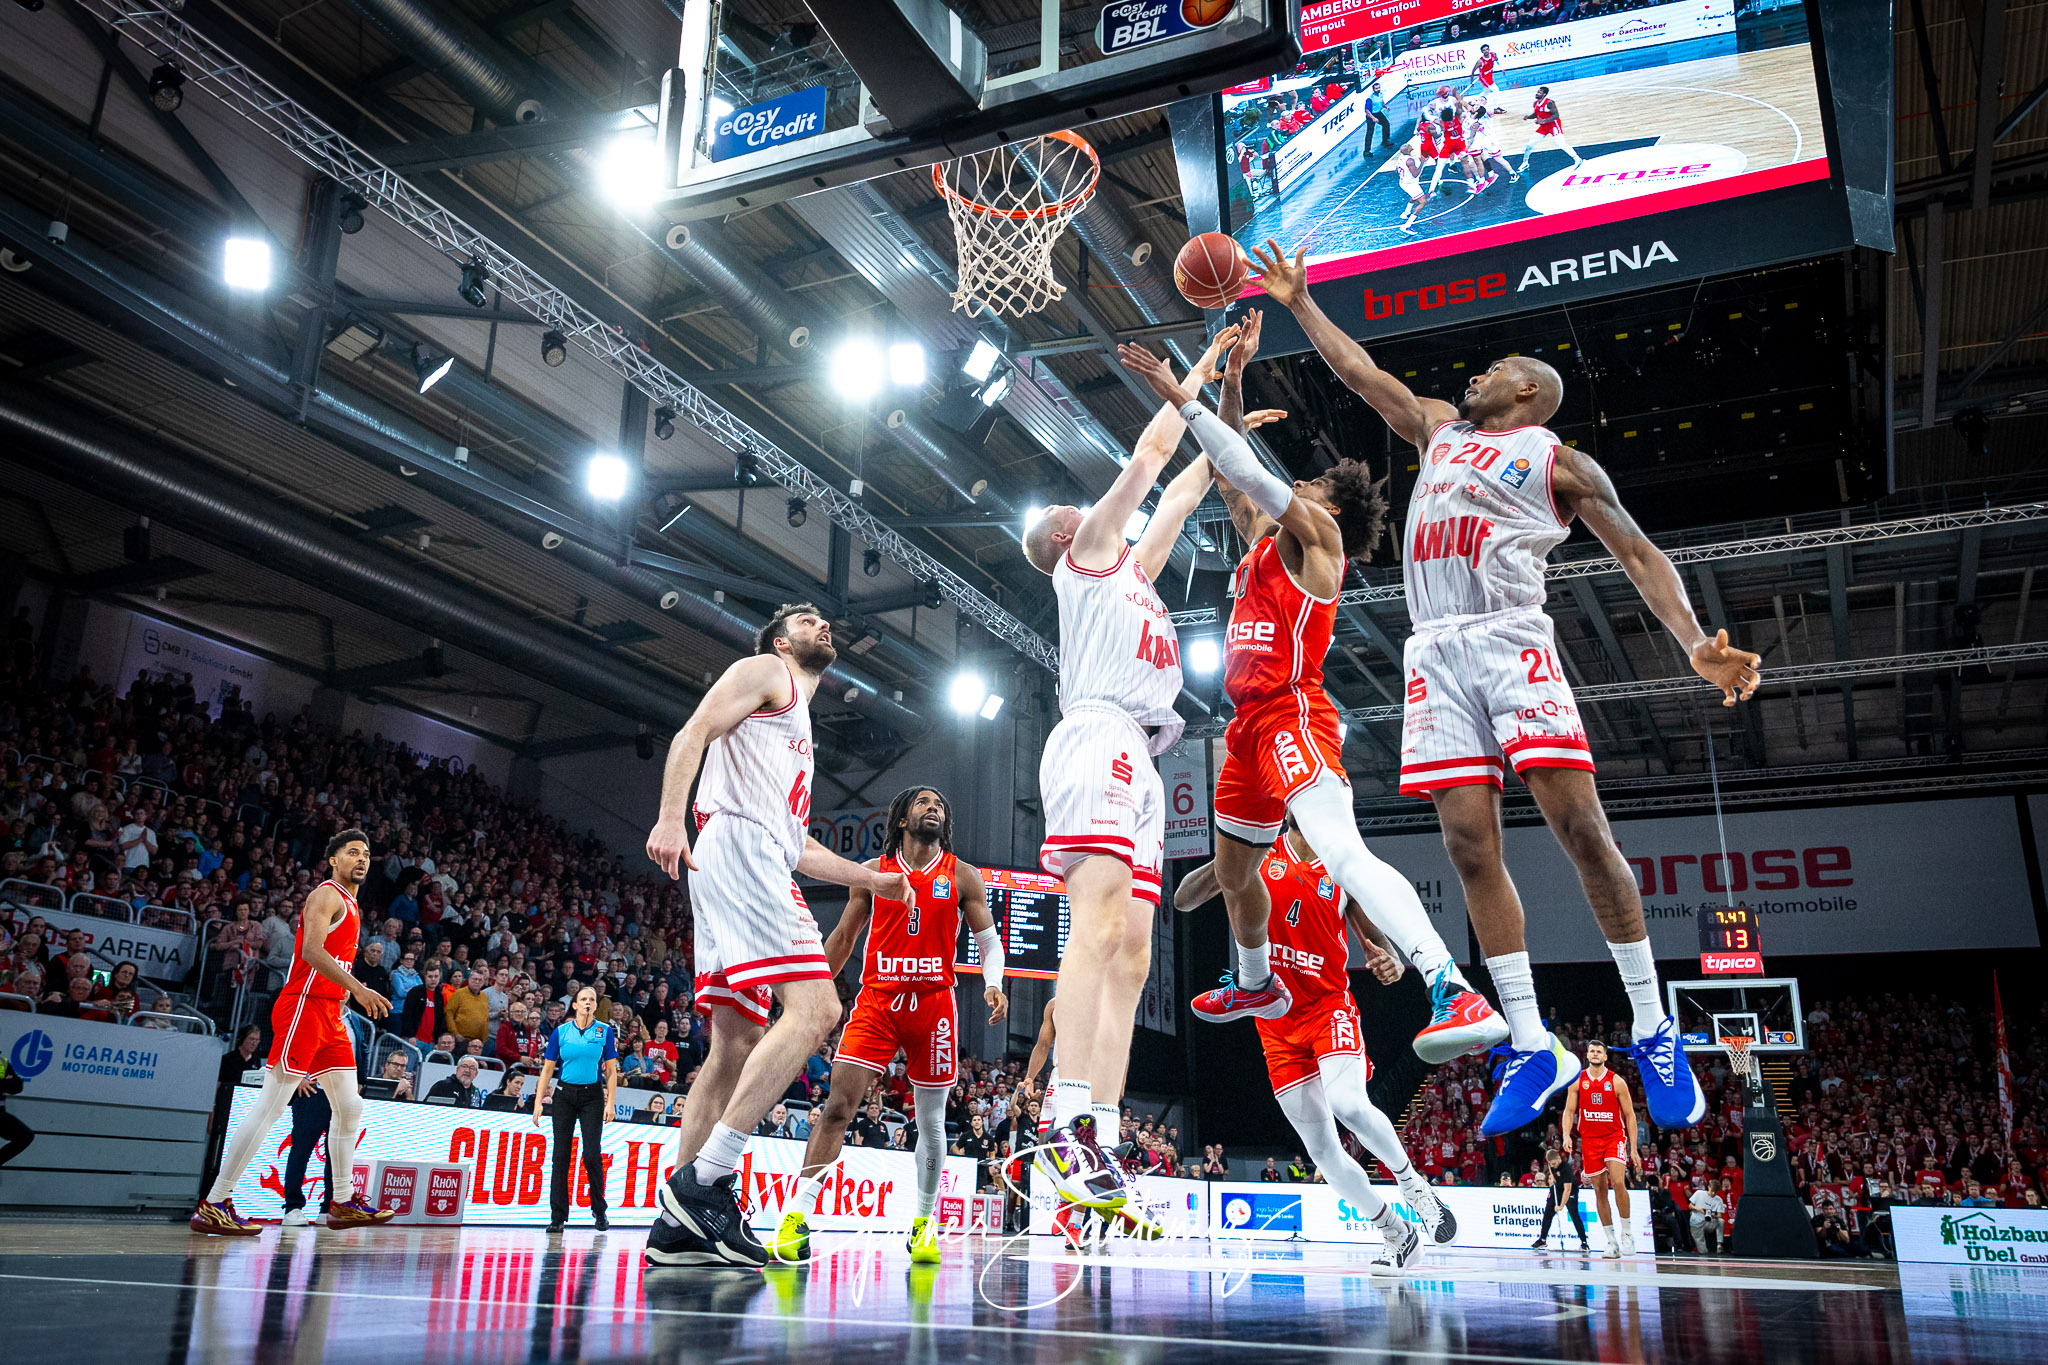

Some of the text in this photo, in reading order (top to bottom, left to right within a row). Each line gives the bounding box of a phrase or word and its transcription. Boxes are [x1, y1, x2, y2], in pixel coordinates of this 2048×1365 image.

[1128, 4, 1168, 22] Credit
[1112, 17, 1167, 48] BBL
[1304, 19, 1345, 37] timeout
[1322, 15, 1401, 45] 0 0
[1404, 49, 1466, 70] MEISNER
[747, 112, 817, 146] Credit
[1322, 102, 1355, 134] TREK
[1562, 163, 1712, 187] brose
[1364, 240, 1679, 321] brose ARENA
[1450, 442, 1501, 472] 20
[1413, 511, 1495, 569] KNAUF
[1228, 621, 1275, 643] ose
[229, 665, 254, 680] GmbH
[1173, 772, 1192, 780] ZISIS
[1172, 783, 1194, 815] 6
[1090, 818, 1118, 826] SPALDING
[907, 907, 920, 935] 3
[1285, 900, 1301, 927] 4
[1725, 929, 1749, 949] 13
[100, 936, 182, 966] ARENA
[877, 951, 943, 973] brose
[1705, 955, 1756, 972] tipico
[64, 1043, 158, 1067] IGARASHI
[61, 1062, 155, 1080] MOTOREN GMBH
[1591, 1093, 1603, 1105] 65
[1583, 1109, 1614, 1119] brose
[449, 1127, 547, 1206] CLUB
[384, 1187, 457, 1197] SPRUDEL SPRUDEL
[1494, 1215, 1542, 1227] Erlangen
[1961, 1225, 2048, 1243] Holzbau
[1964, 1241, 2017, 1262] Übel
